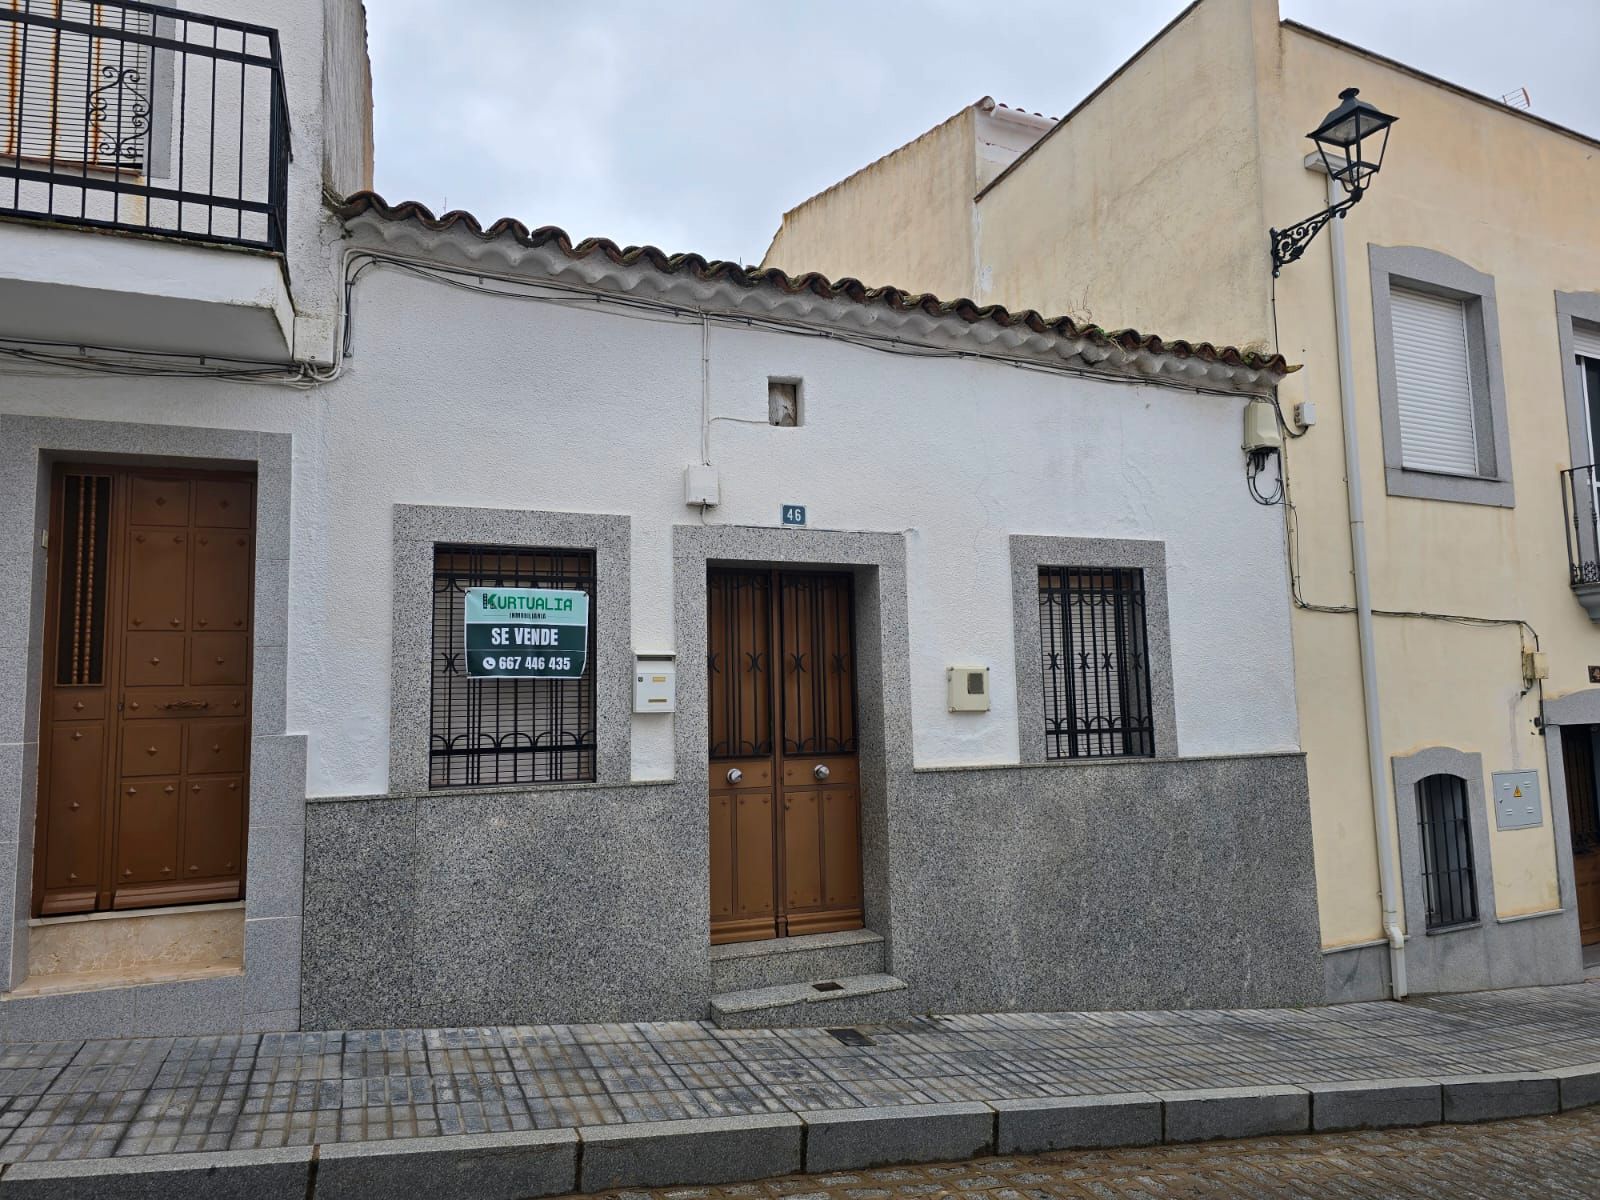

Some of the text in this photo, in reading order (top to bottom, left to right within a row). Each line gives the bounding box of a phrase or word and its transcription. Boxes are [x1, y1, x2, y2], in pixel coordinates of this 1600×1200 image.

[787, 508, 801, 521] 46
[482, 593, 573, 611] KURTUALIA
[491, 627, 559, 646] SE VENDE
[498, 656, 571, 670] 667 446 435
